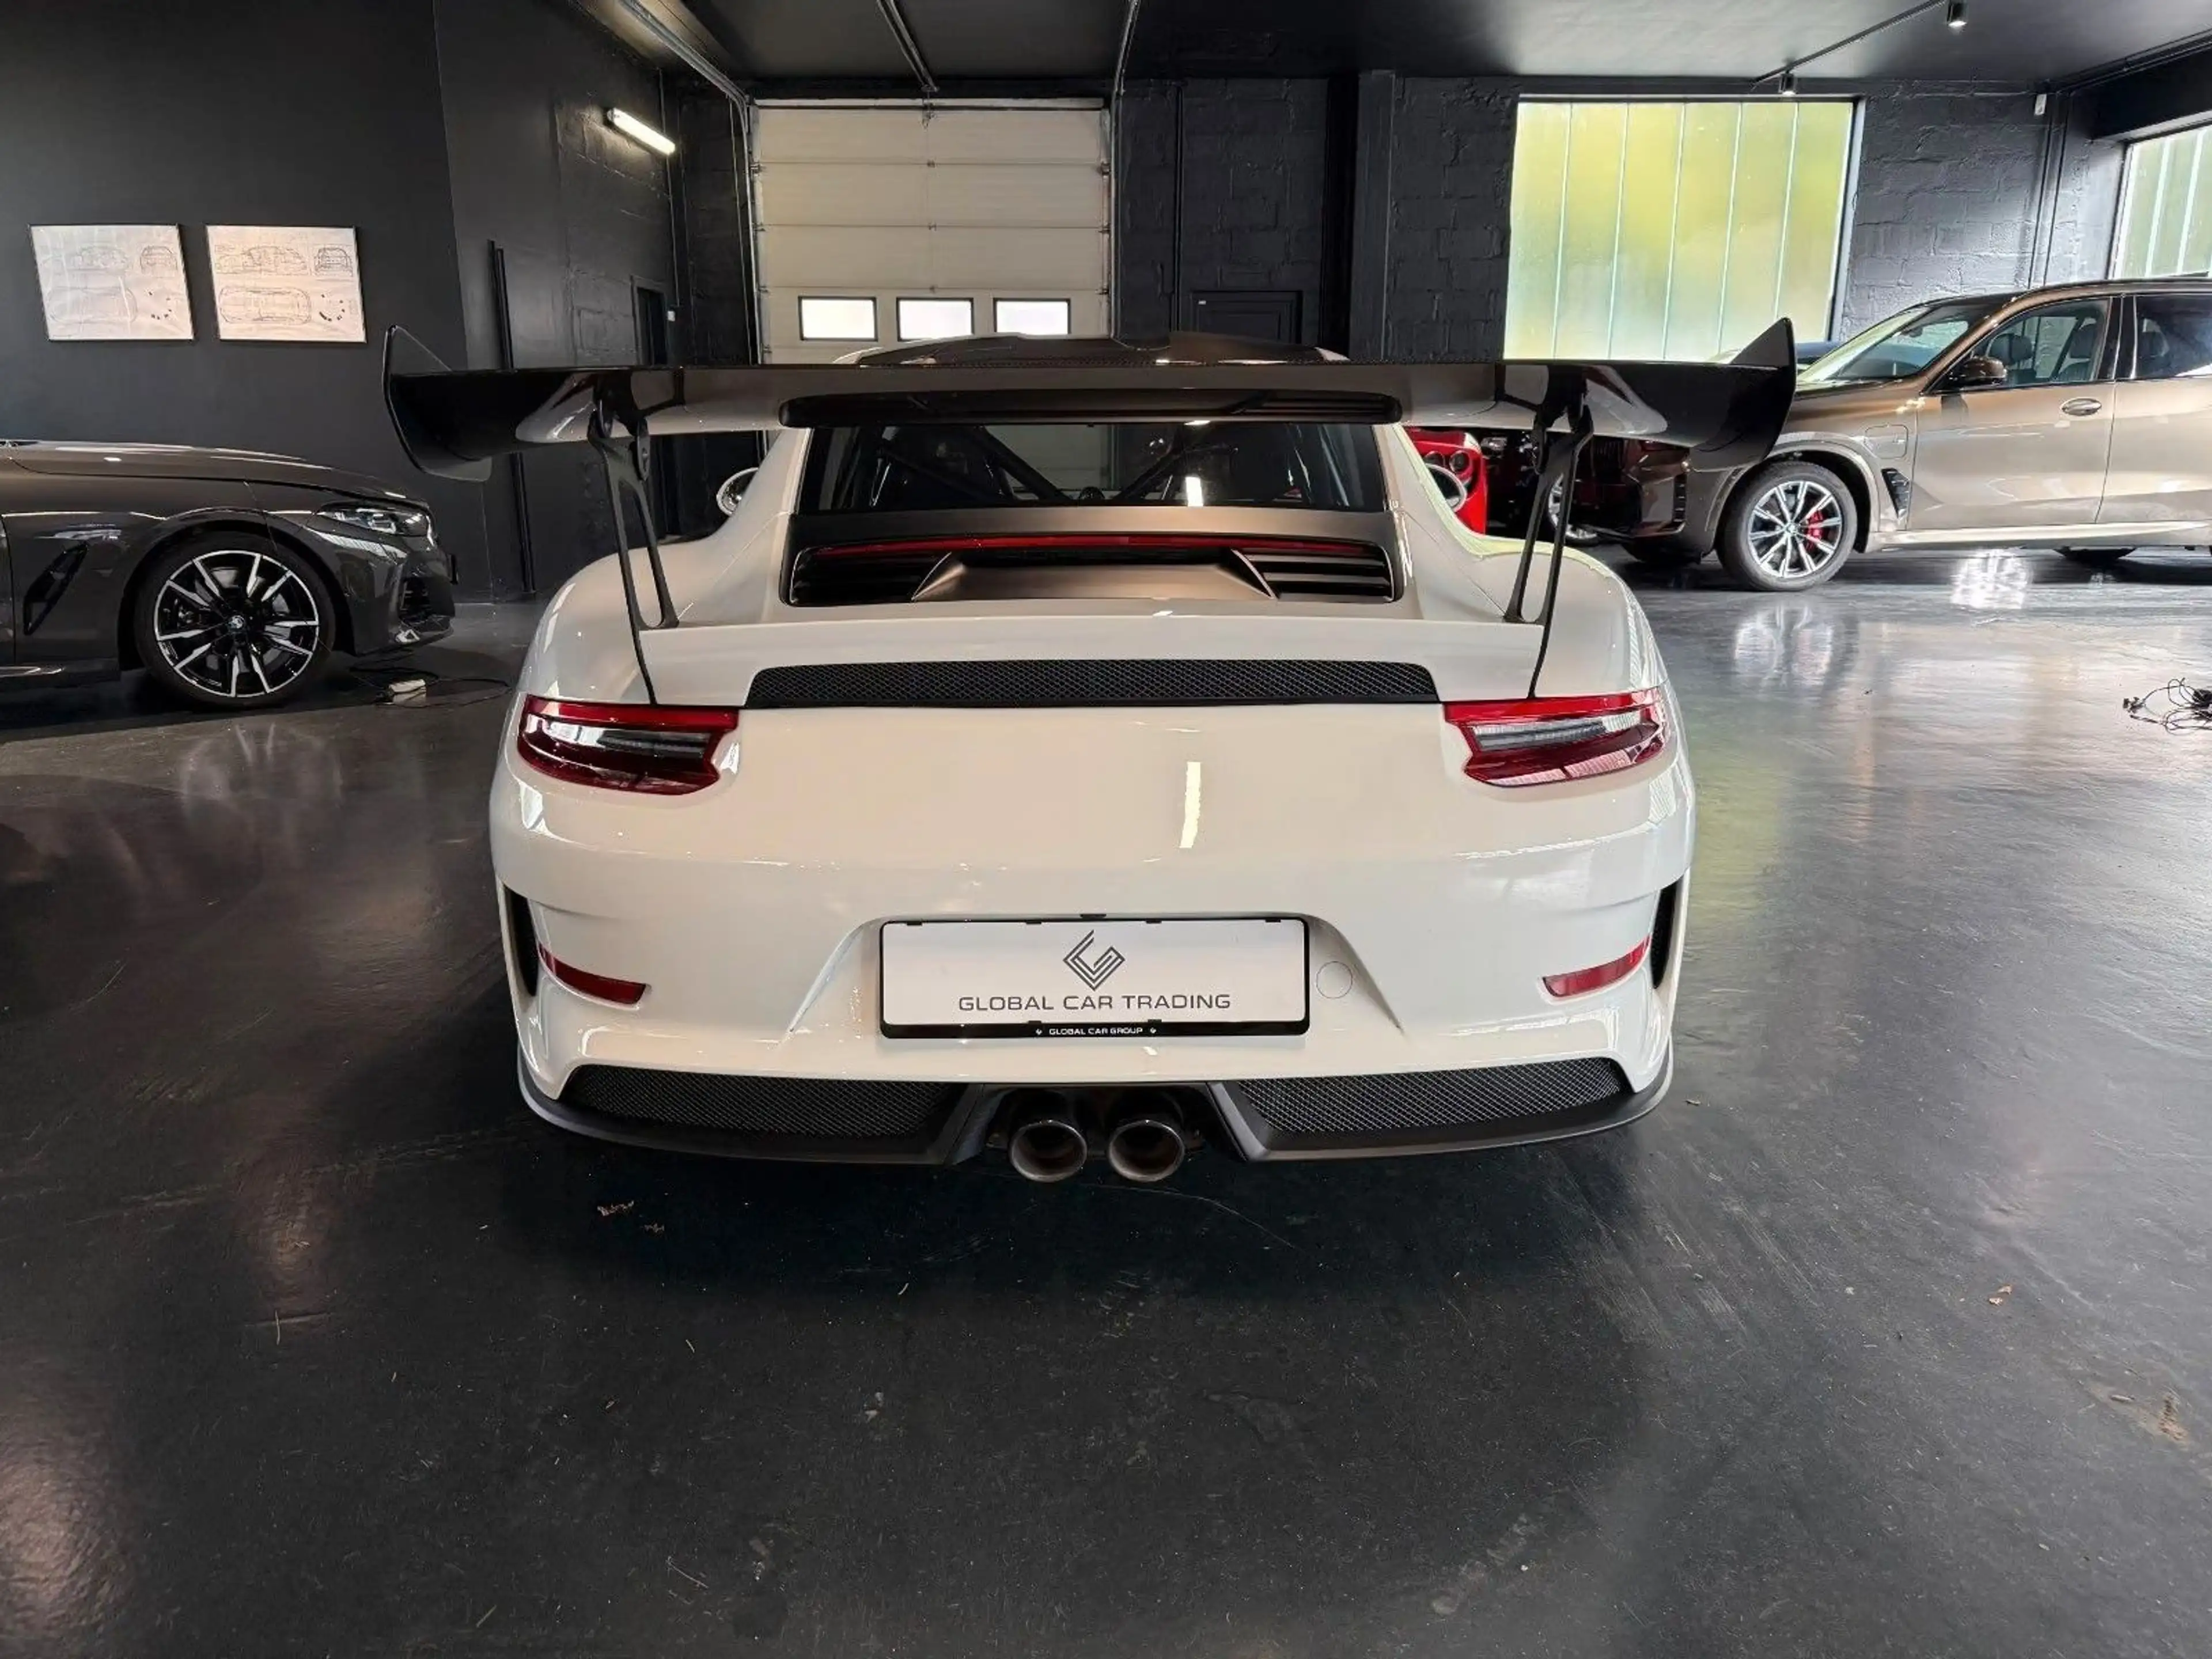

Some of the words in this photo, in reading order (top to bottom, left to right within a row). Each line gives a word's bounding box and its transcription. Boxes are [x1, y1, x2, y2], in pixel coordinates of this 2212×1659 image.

[959, 996, 1054, 1011] GLOBAL
[1063, 995, 1113, 1010] CAR
[1122, 994, 1230, 1009] TRADING
[1048, 1028, 1086, 1036] GLOBAL
[1088, 1027, 1108, 1035] CAR
[1109, 1027, 1143, 1035] GROUP
